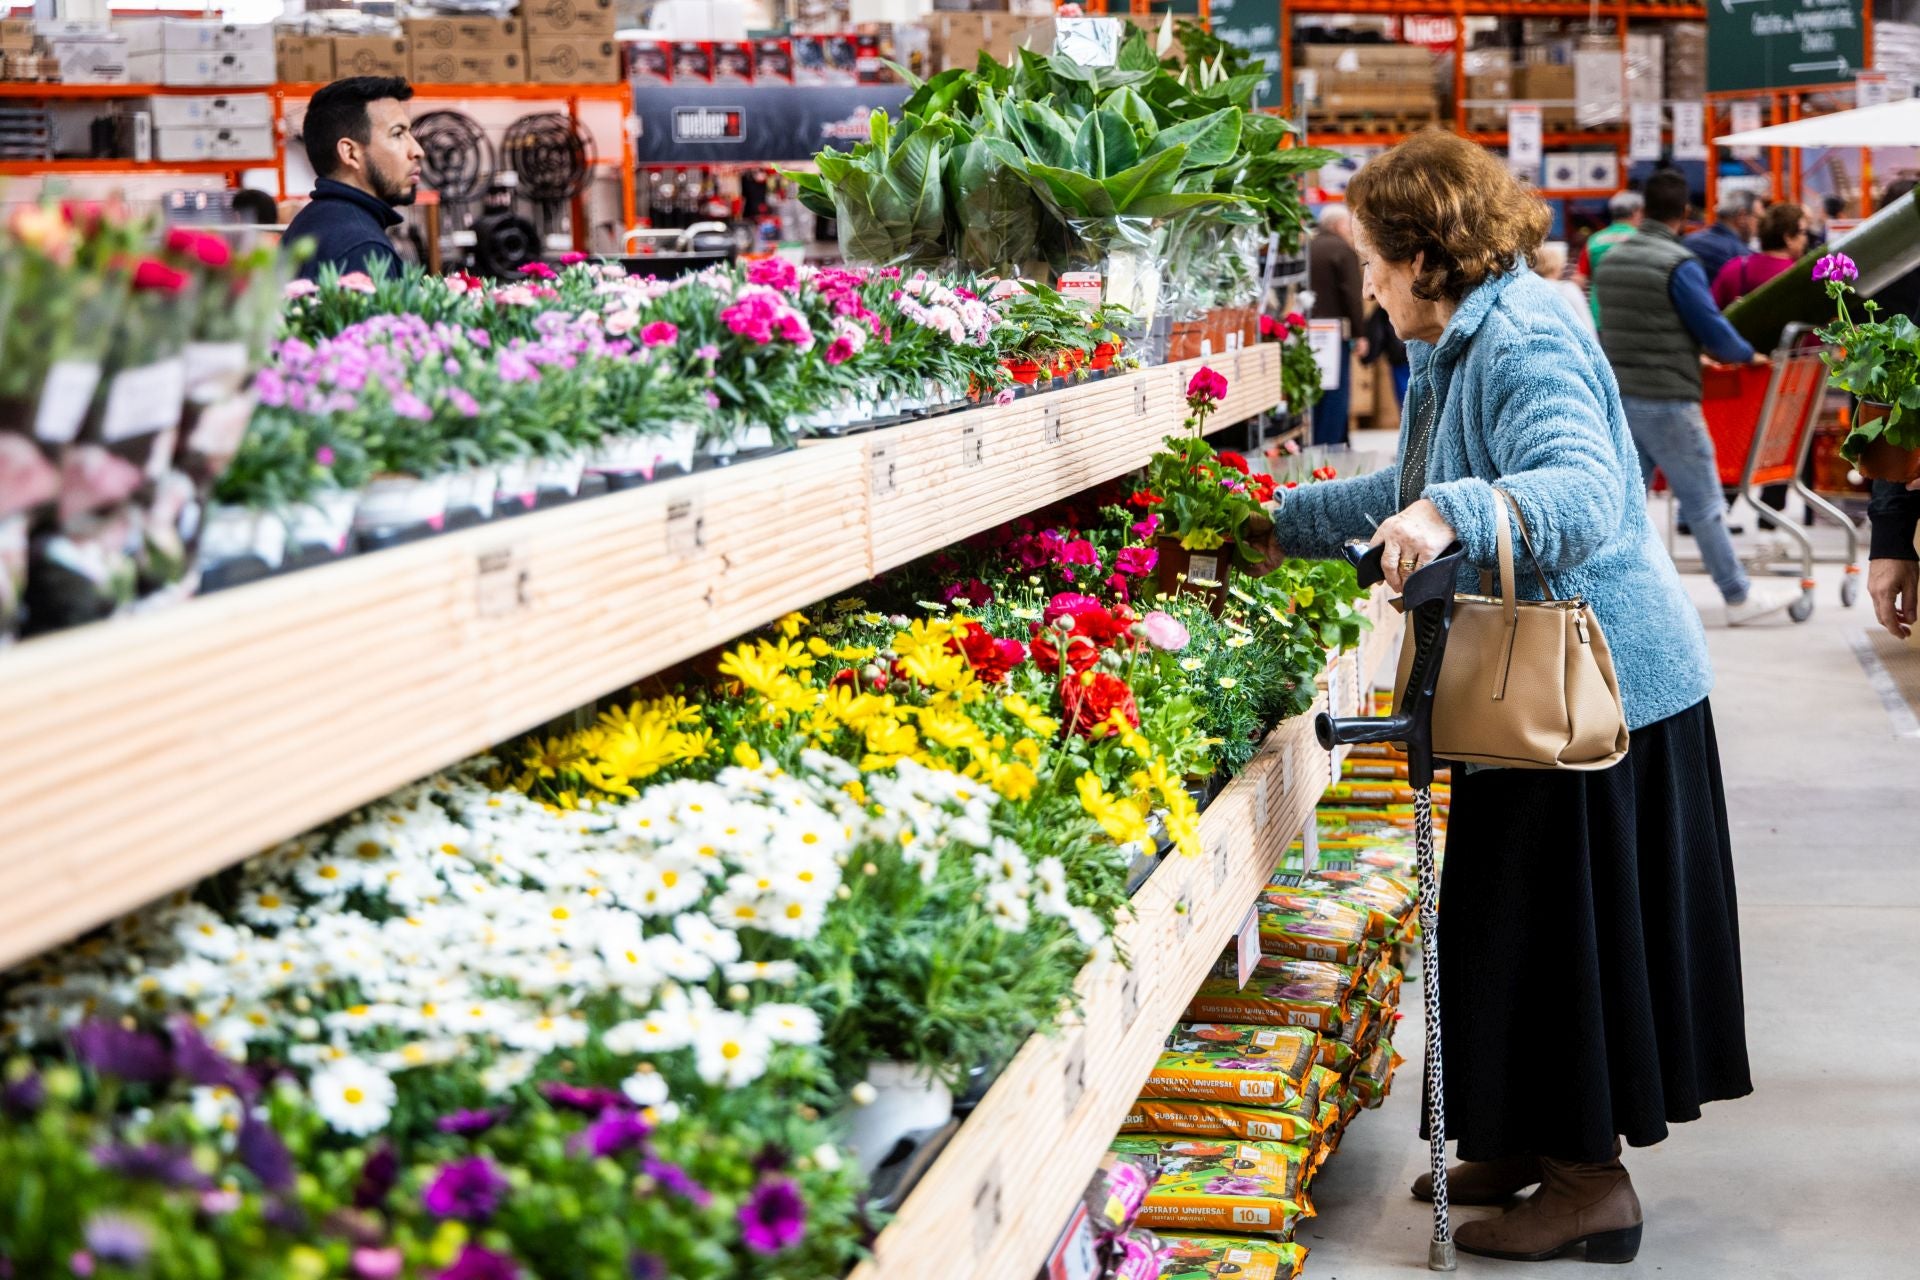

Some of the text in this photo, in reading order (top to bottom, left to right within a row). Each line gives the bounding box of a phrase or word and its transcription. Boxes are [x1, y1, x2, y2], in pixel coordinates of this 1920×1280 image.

[1312, 947, 1324, 958] 10
[1296, 1013, 1307, 1025] 10
[1192, 1079, 1234, 1088] UNIVERSAL
[1247, 1083, 1260, 1094] 10
[1121, 1114, 1144, 1124] ERDE
[1155, 1112, 1241, 1127] SUBSTRATO UNIERSAL
[1254, 1123, 1267, 1135] 10
[1139, 1206, 1226, 1215] UBSTRATO UNIVERSAL
[1240, 1209, 1254, 1221] 10
